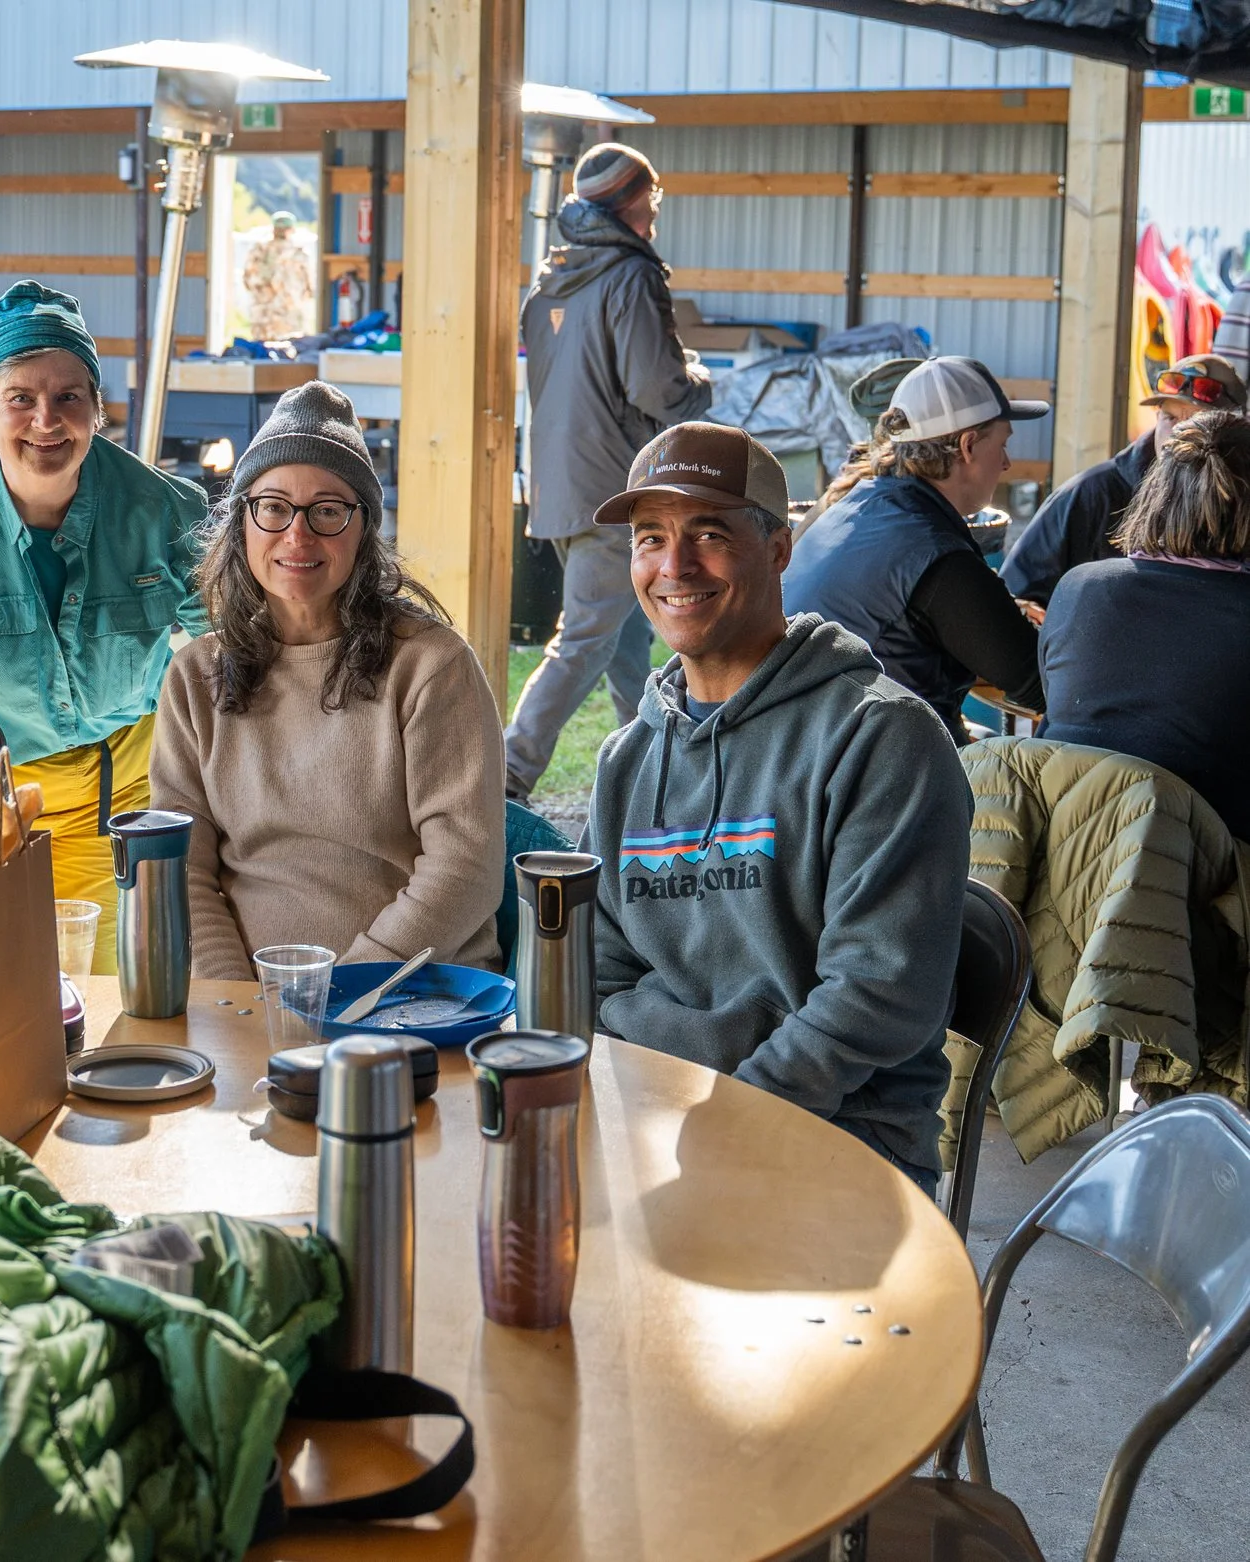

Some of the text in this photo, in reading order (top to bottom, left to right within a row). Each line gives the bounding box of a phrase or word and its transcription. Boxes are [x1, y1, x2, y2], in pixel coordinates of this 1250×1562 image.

[655, 462, 722, 476] WMAC North Slope
